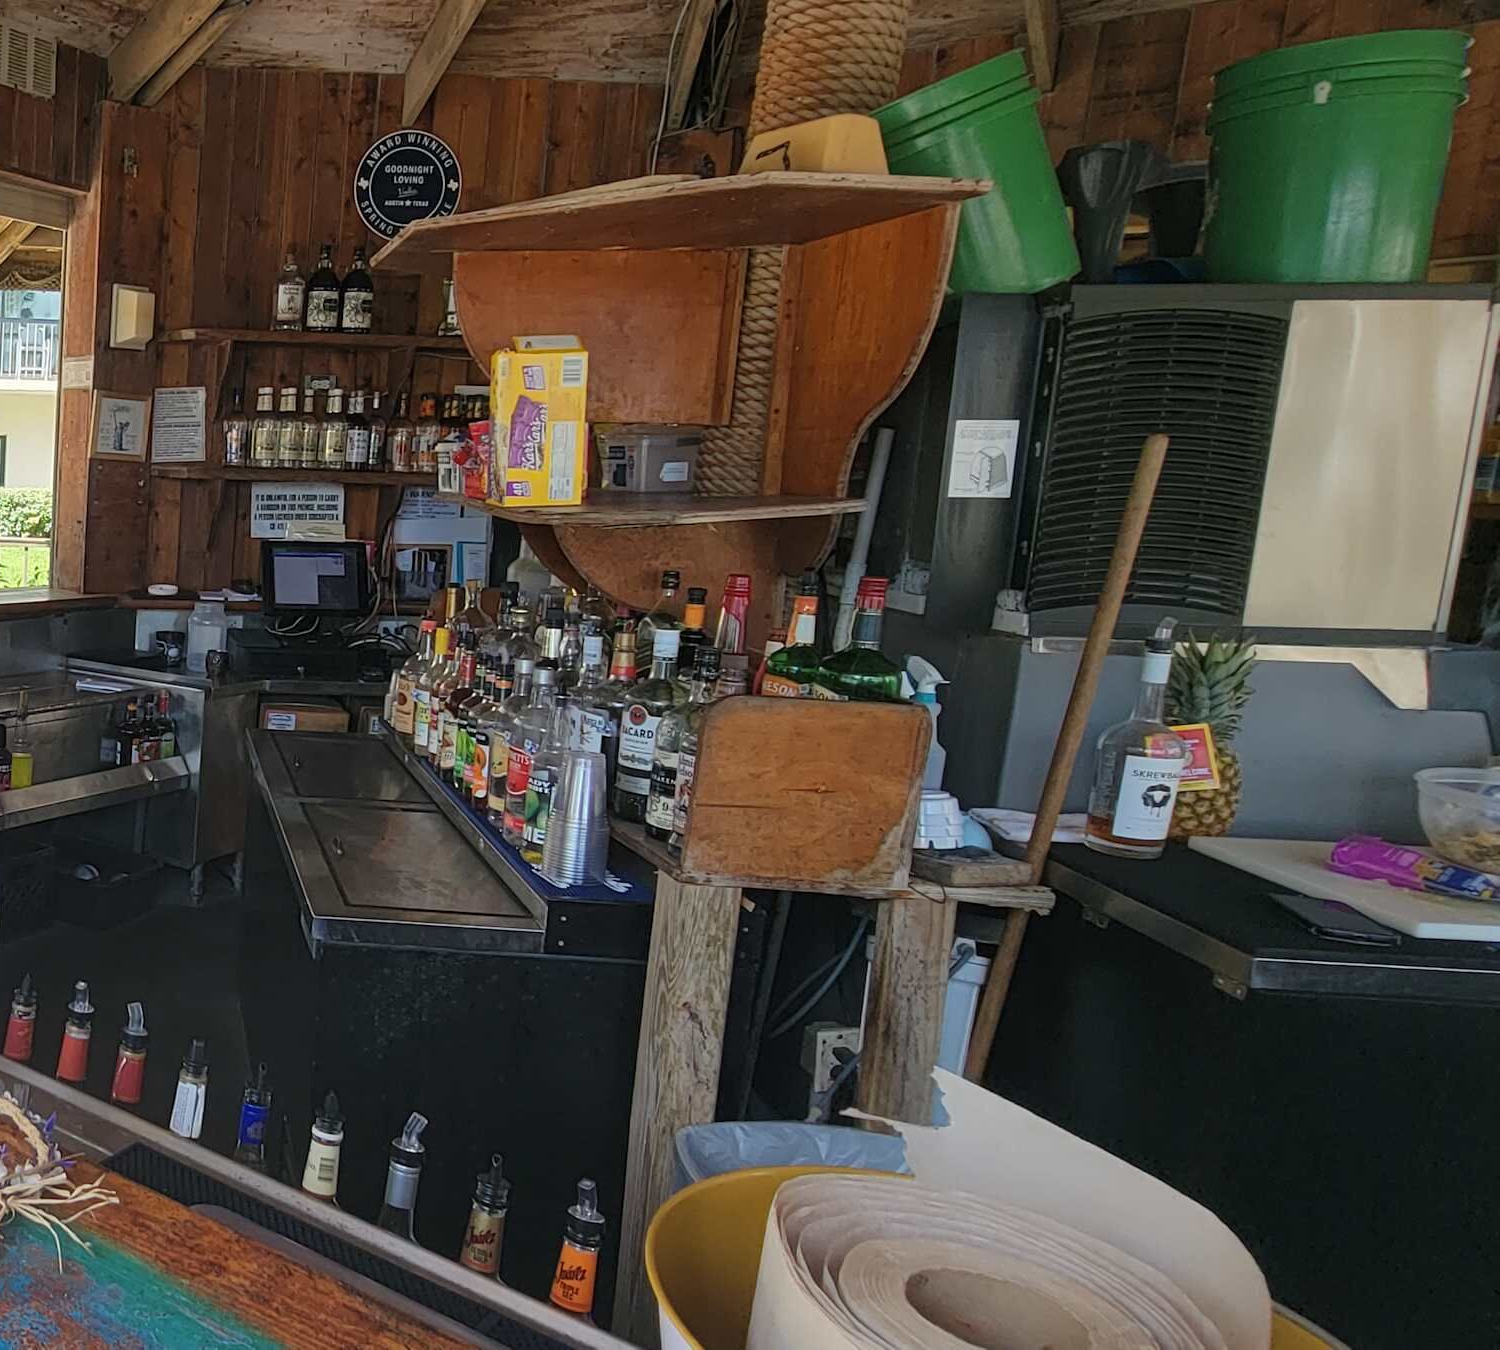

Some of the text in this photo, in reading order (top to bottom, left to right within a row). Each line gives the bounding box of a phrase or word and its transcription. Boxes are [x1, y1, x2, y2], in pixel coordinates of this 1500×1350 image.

[366, 134, 453, 167] AWARD WINNING
[385, 165, 434, 174] GOODNIGHT
[394, 176, 424, 184] LOVING
[361, 201, 394, 234] SPRING
